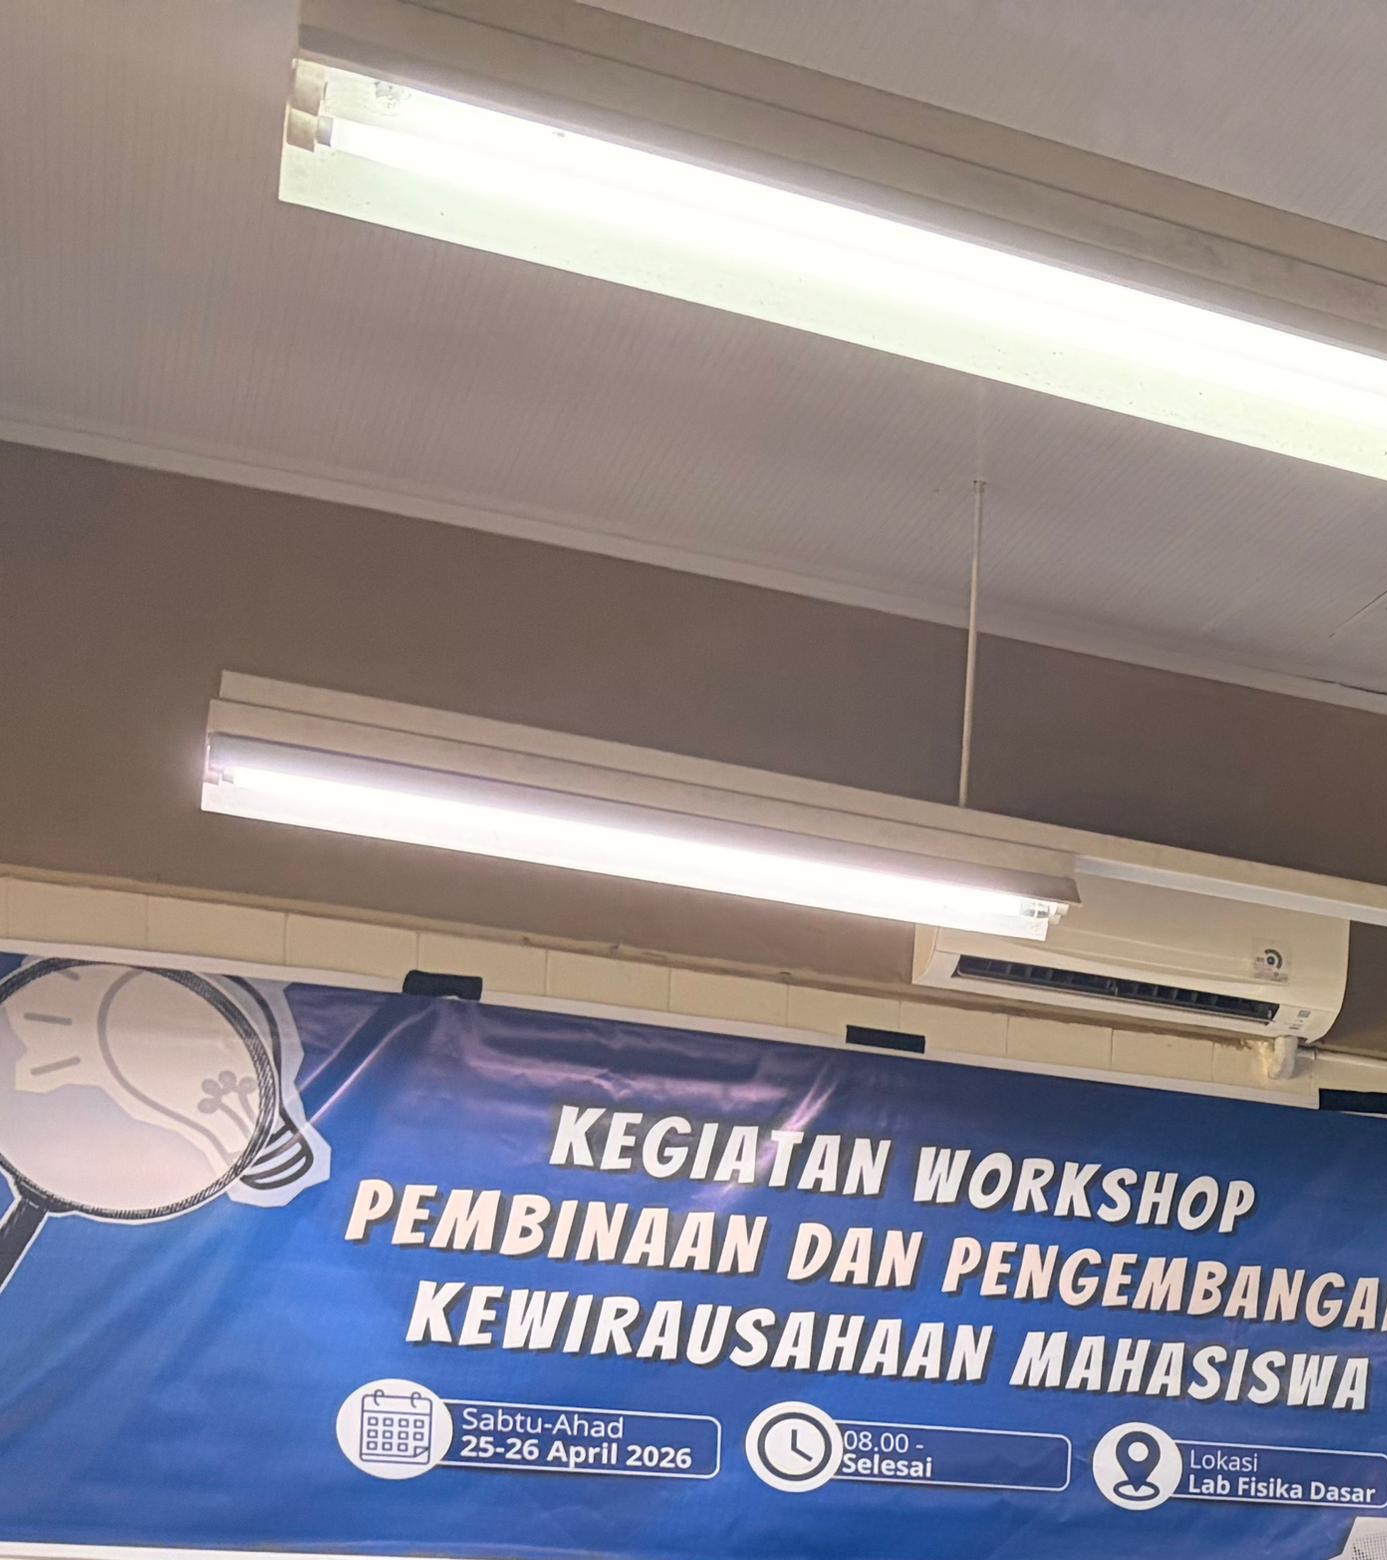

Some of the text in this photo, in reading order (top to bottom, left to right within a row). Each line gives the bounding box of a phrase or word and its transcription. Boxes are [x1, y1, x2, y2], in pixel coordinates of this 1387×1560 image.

[549, 1104, 1256, 1234] KEGIATAN WORKSHOP
[344, 1179, 768, 1275] PEMBINAAN
[786, 1222, 923, 1289] DAN
[405, 1280, 1370, 1411] KEWIRAUSAHAAN MAHASISWA
[461, 1407, 624, 1440] Sabtu-Ahad
[460, 1435, 692, 1469] 25-26 April 2026
[844, 1430, 909, 1453] 08.00
[842, 1453, 932, 1477] Selesai
[1189, 1449, 1258, 1472] Lokasi
[1189, 1474, 1376, 1503] Lab Fisika Dasar
